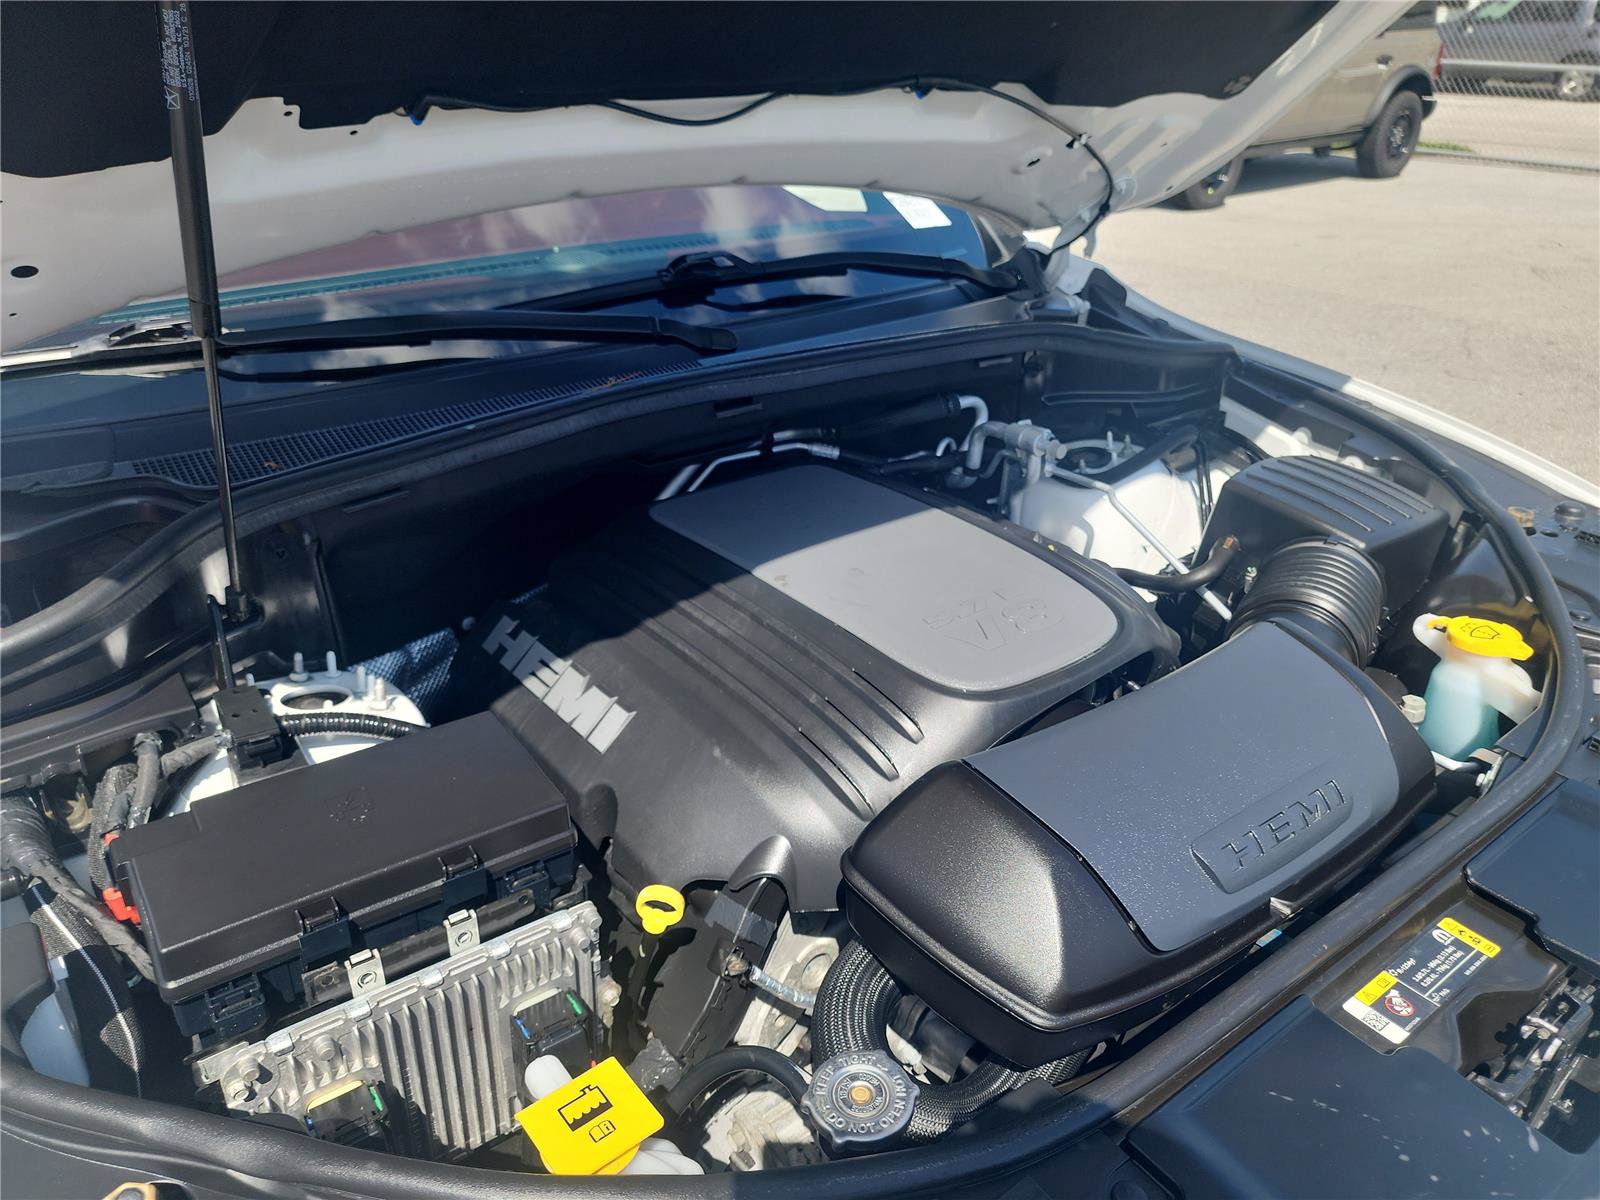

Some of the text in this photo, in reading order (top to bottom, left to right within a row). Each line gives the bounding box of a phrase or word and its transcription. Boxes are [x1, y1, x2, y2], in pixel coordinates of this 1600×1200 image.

[944, 594, 1065, 652] V8
[481, 614, 638, 755] HEMI
[1220, 779, 1347, 873] HEMI
[815, 1065, 835, 1095] KEEP
[838, 1054, 877, 1066] TIGHT
[826, 1112, 847, 1129] DO
[847, 1122, 876, 1134] NOT
[878, 1099, 906, 1129] OPEN
[892, 1075, 907, 1097] HOT
